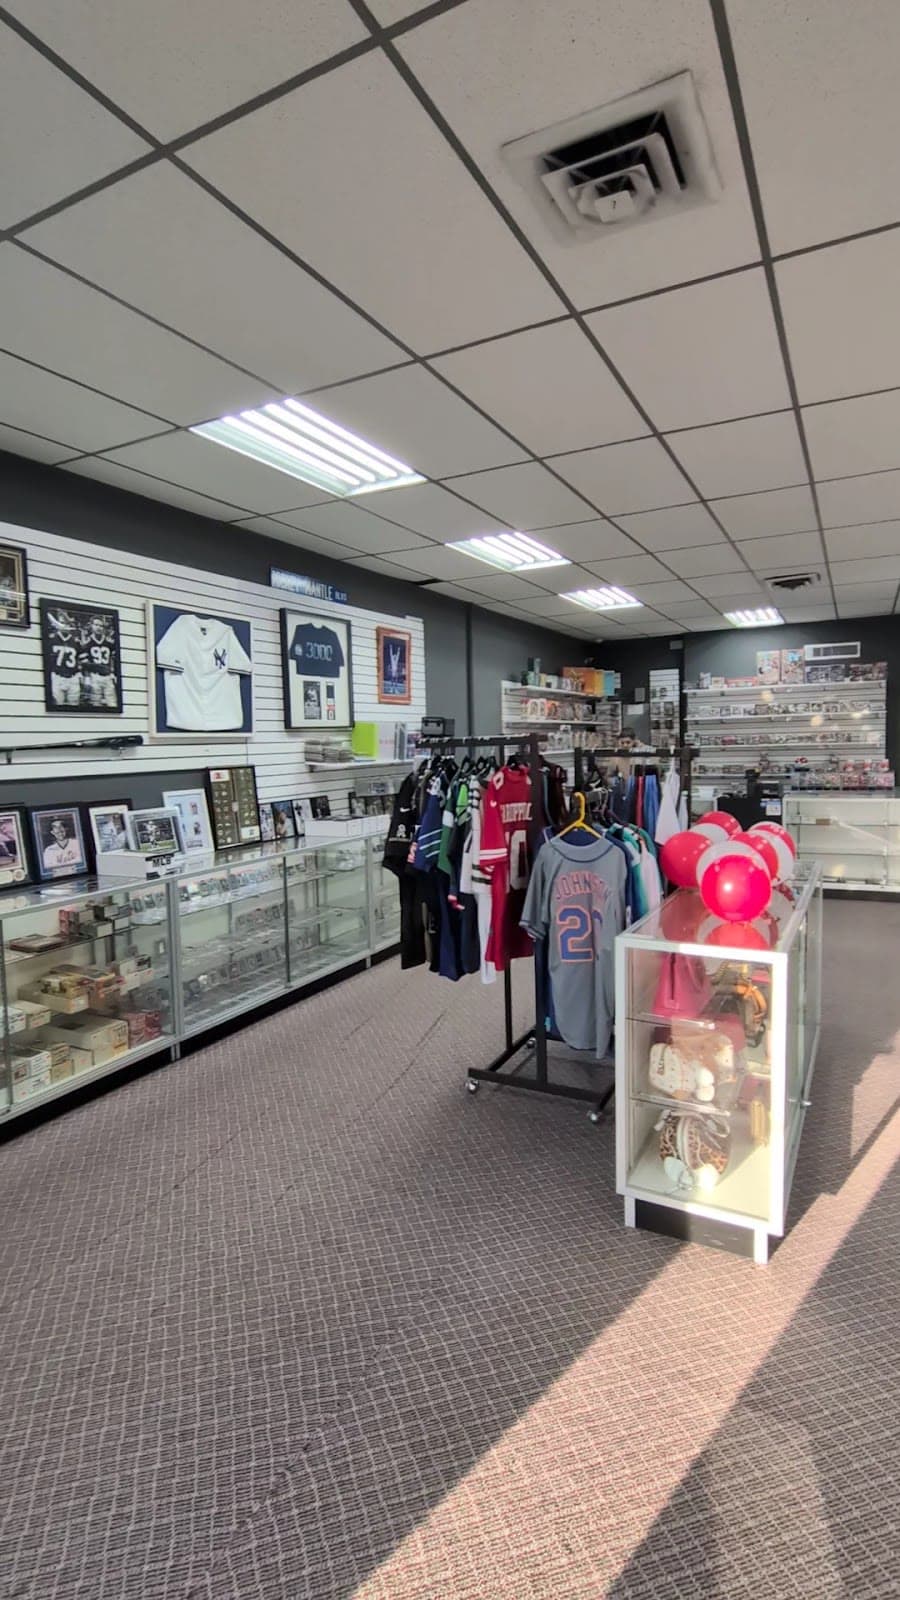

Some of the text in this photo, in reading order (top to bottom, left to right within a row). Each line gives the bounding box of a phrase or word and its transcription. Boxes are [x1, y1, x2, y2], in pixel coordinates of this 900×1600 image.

[303, 577, 334, 601] MANTLE
[52, 645, 77, 669] 73
[90, 646, 111, 665] 93
[213, 648, 227, 670] NY
[305, 641, 333, 662] 3000
[152, 852, 172, 868] MLB
[556, 871, 607, 904] JOHNSO
